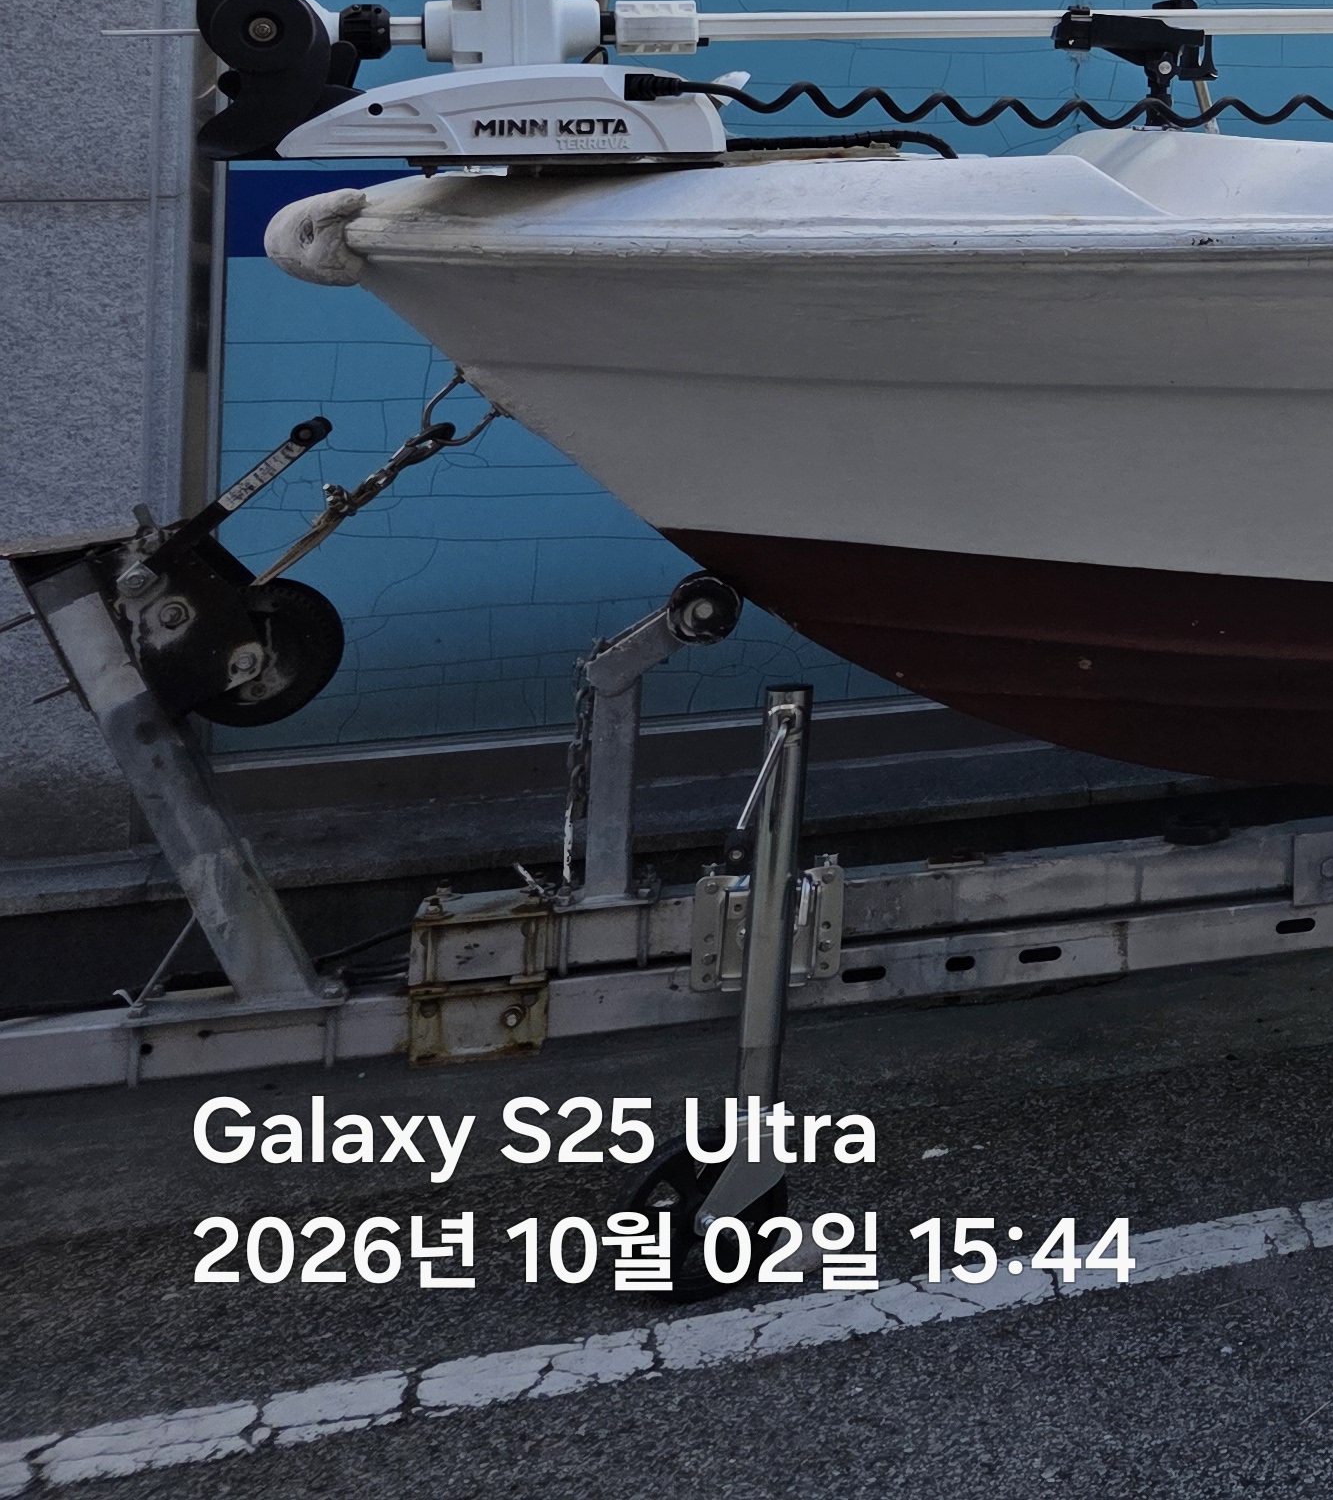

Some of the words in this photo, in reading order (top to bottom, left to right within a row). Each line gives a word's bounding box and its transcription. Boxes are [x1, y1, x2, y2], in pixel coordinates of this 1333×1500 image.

[473, 118, 549, 137] MINN
[557, 117, 630, 136] KOTA
[556, 137, 630, 151] TERROVA
